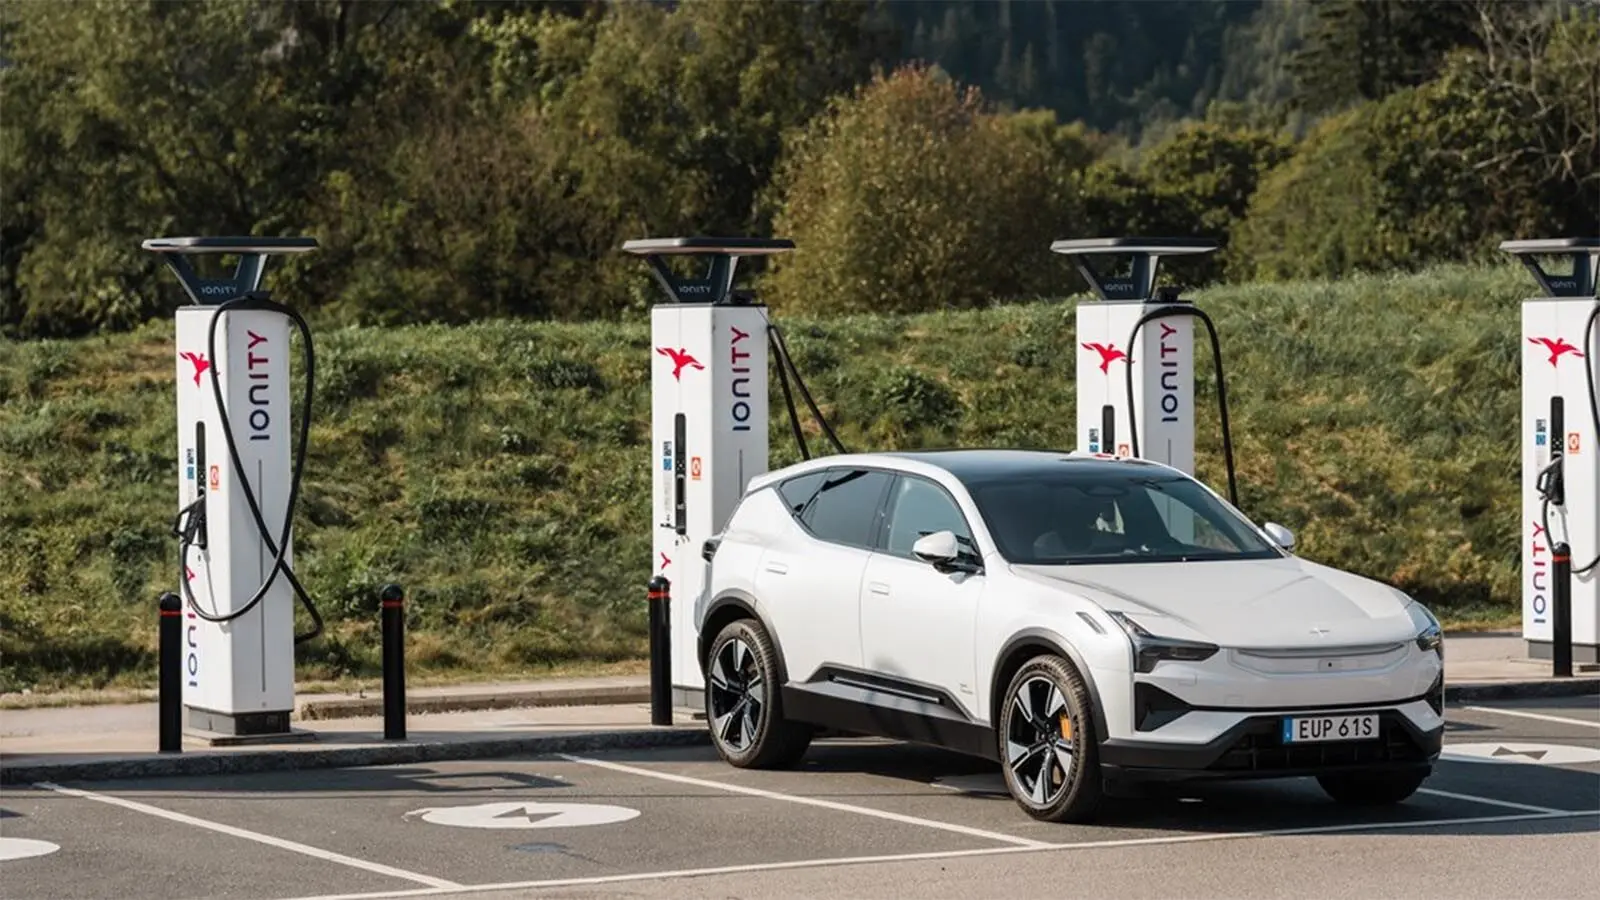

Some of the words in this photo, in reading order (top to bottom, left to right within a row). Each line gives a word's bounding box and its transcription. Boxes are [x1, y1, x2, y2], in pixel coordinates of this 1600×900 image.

[247, 330, 270, 441] IONITY
[731, 326, 751, 431] IONITY
[1160, 322, 1178, 422] IONITY
[1532, 520, 1546, 624] IONITY
[184, 564, 198, 687] IONIY
[1300, 719, 1332, 739] EUP
[1338, 717, 1372, 737] 61S
